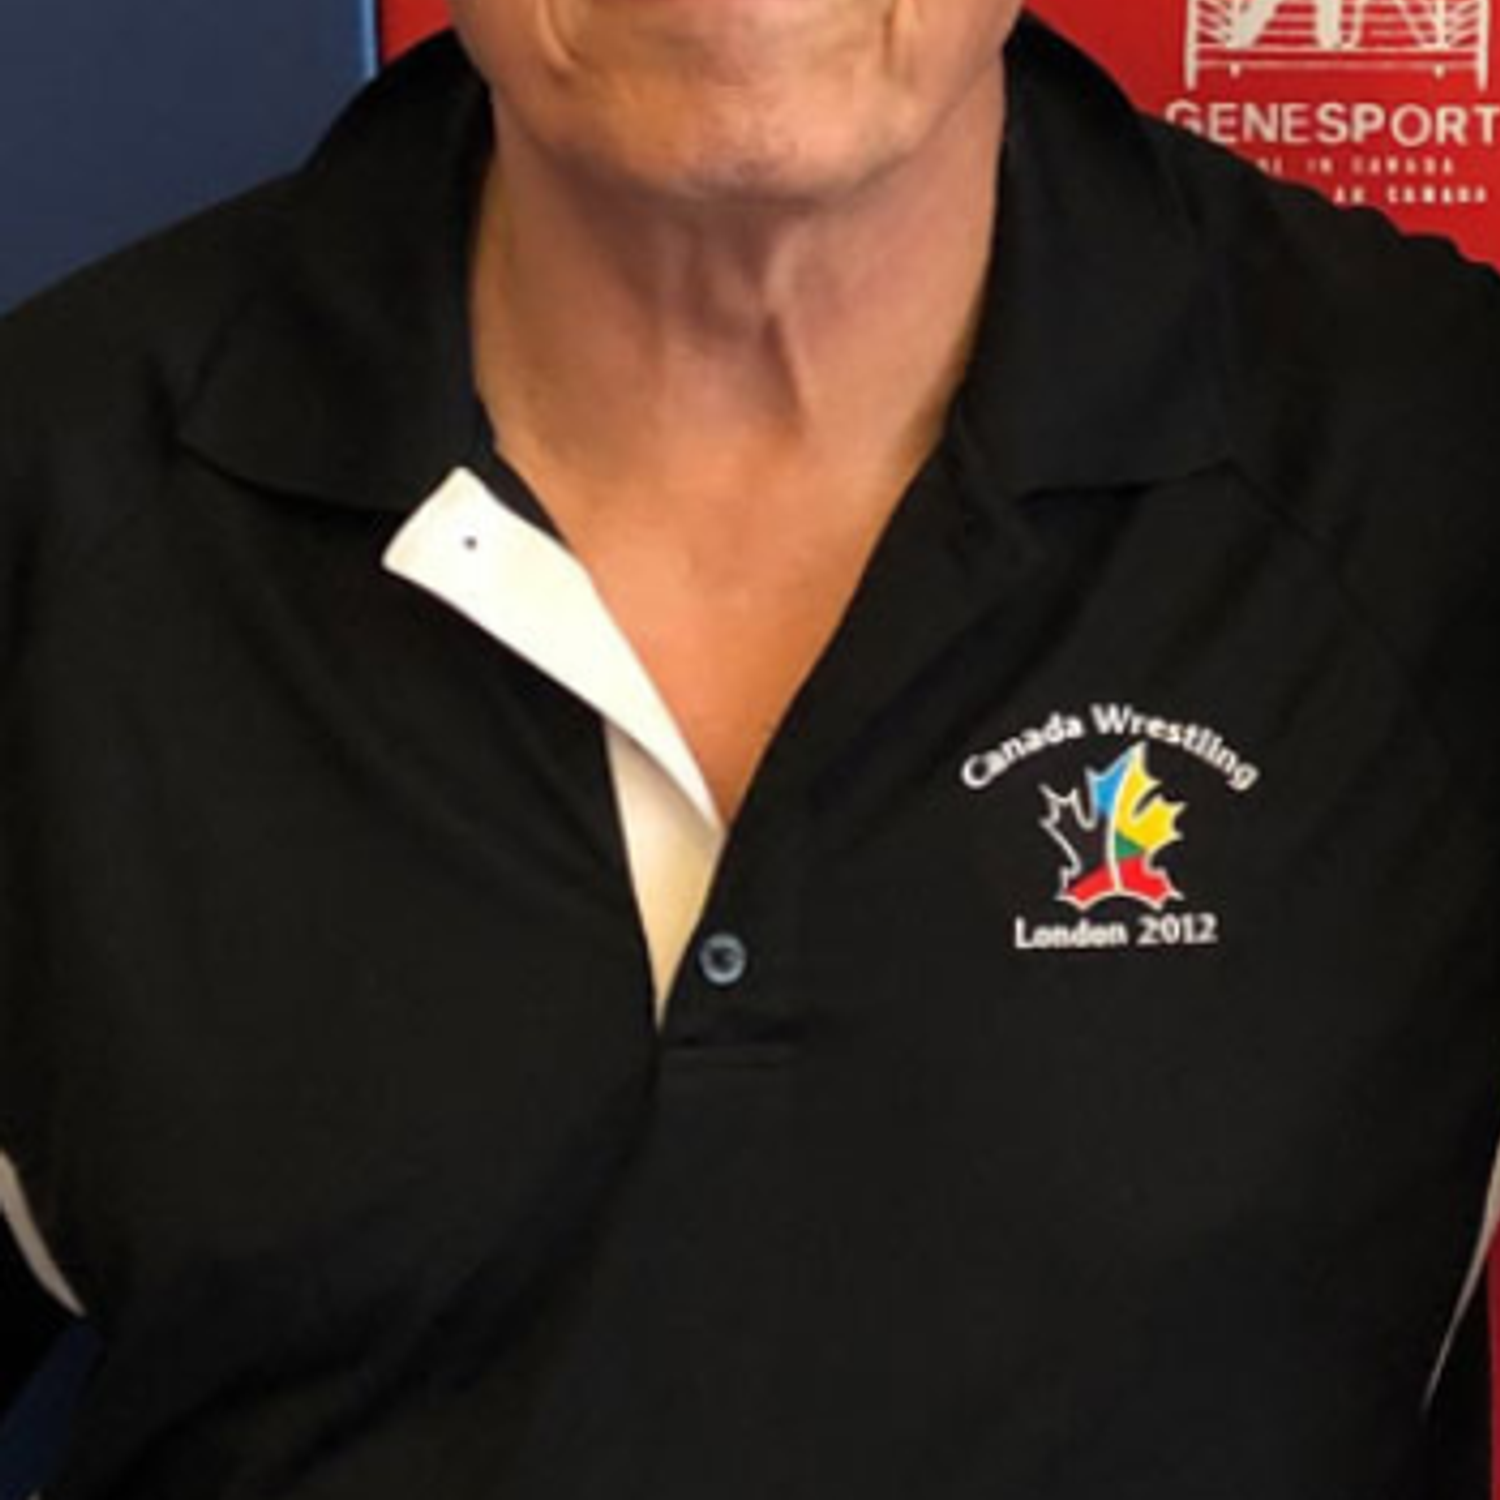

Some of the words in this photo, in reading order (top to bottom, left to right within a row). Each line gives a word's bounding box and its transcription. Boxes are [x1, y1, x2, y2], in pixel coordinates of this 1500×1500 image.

[960, 711, 1085, 789] Canada
[1091, 702, 1260, 791] Wrestling
[1014, 916, 1128, 949] London
[1136, 911, 1218, 945] 2012
